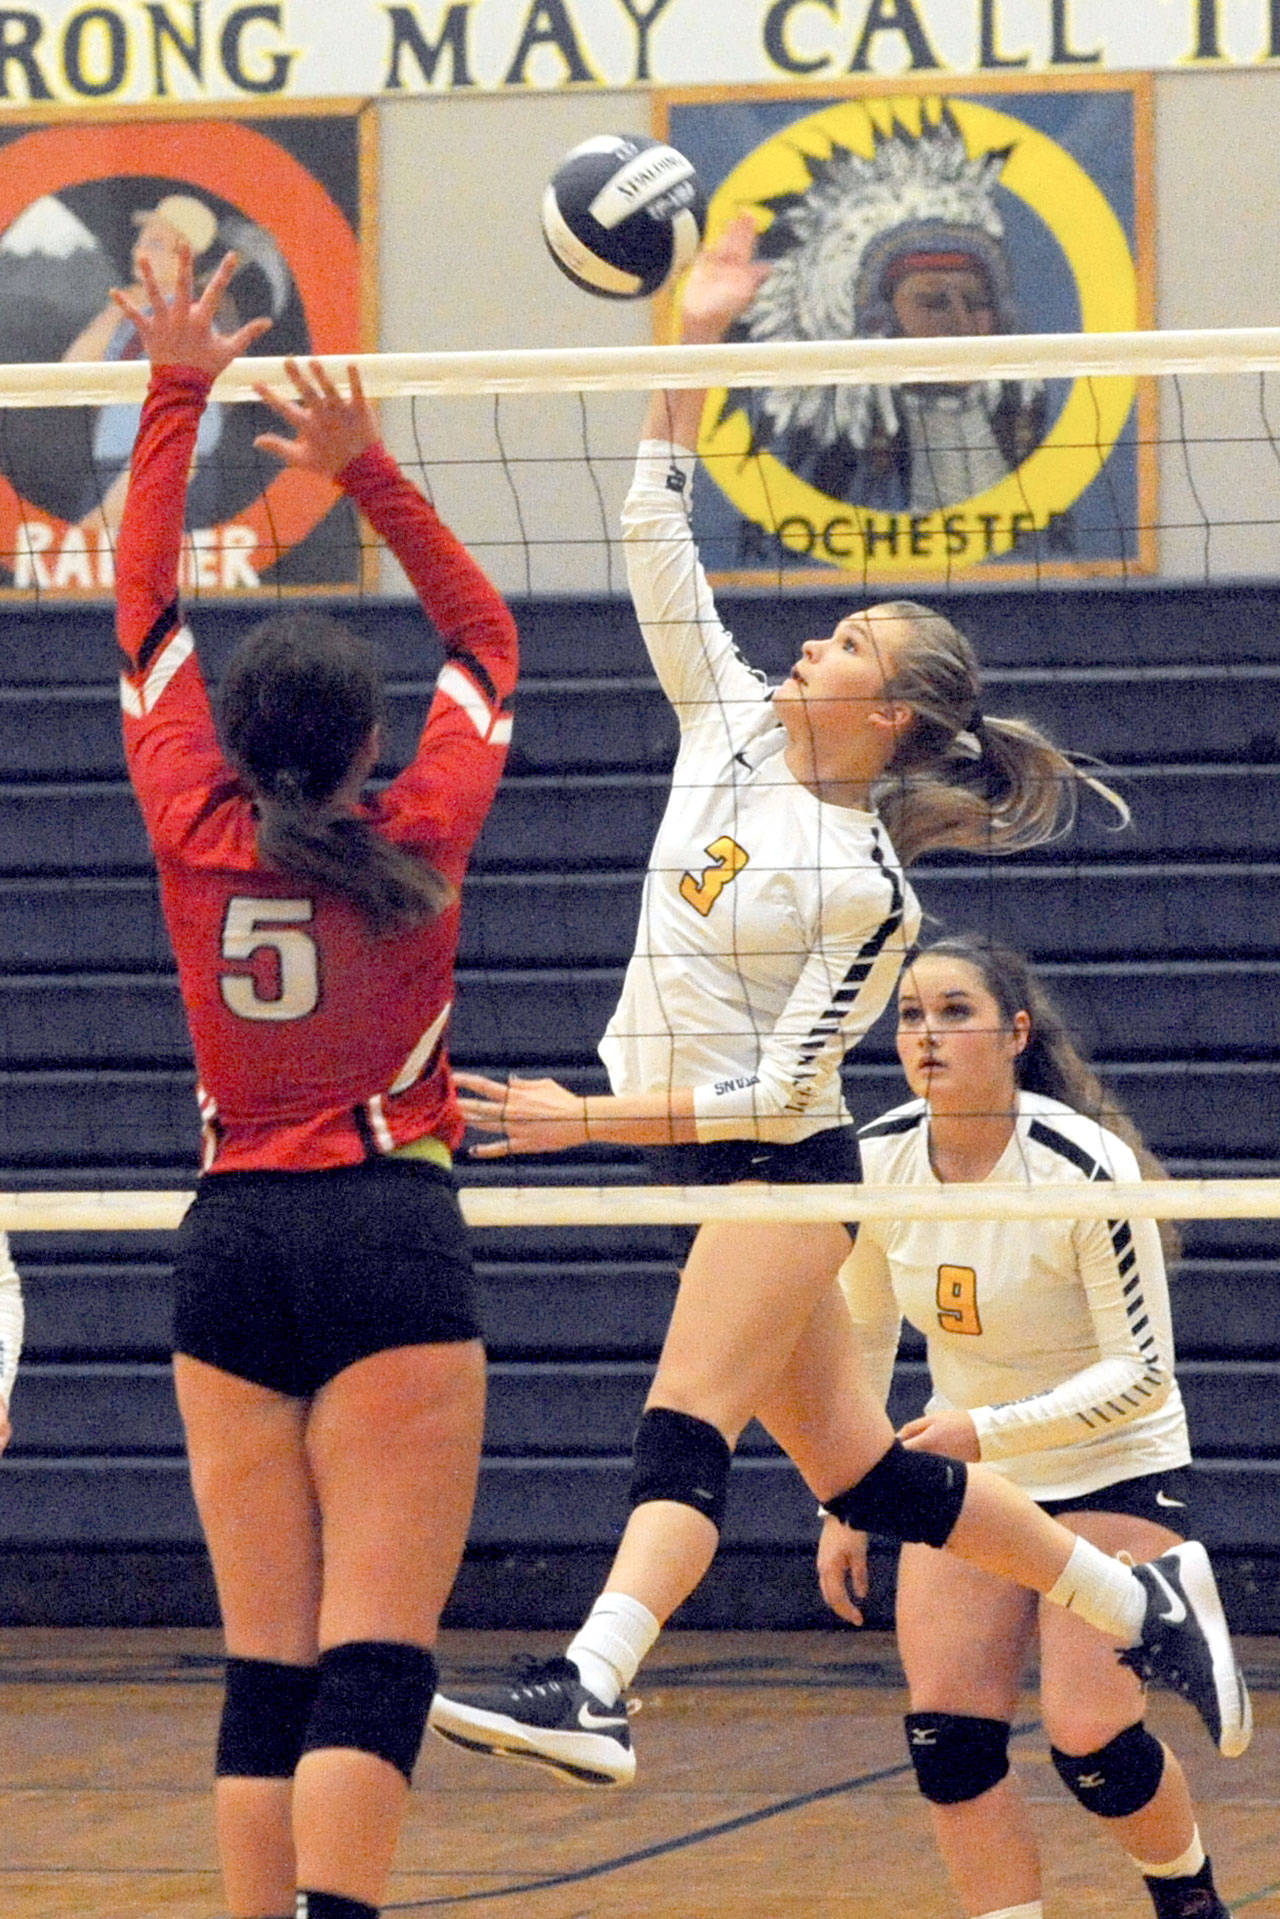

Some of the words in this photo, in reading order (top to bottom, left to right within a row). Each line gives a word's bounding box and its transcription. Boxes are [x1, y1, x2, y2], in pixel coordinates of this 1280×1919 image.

[384, 0, 672, 88] MAY
[762, 0, 1102, 74] CALL
[13, 521, 261, 590] RAIER
[738, 510, 1074, 562] ROCHESTER
[678, 834, 750, 918] 3
[218, 894, 323, 1022] 5
[936, 1263, 983, 1336] 9
